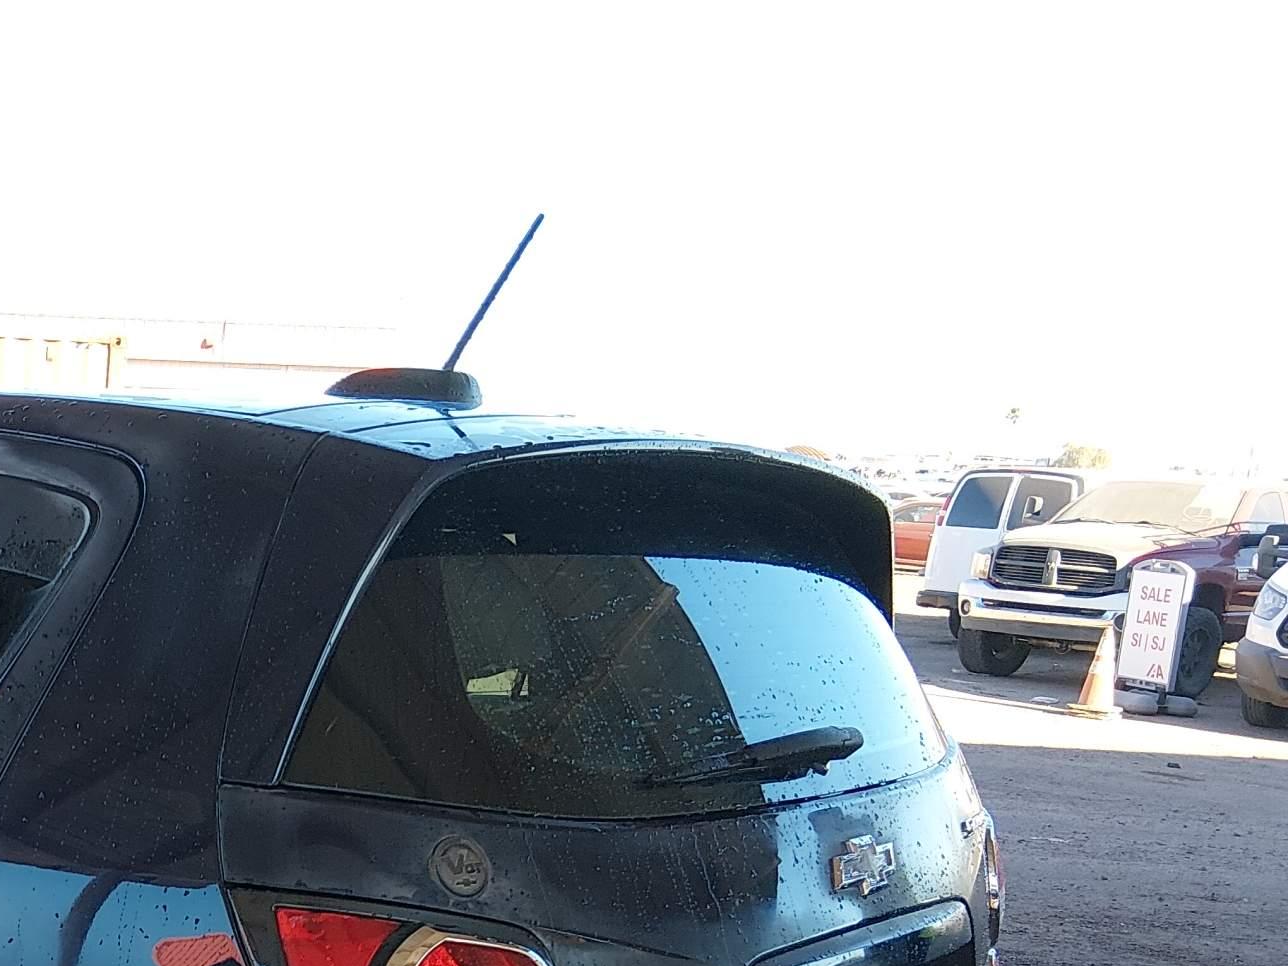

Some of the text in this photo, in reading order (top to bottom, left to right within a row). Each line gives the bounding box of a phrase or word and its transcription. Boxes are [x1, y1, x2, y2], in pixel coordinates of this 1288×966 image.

[1140, 585, 1172, 603] SALE
[1136, 609, 1168, 627] LANE
[1131, 632, 1143, 648] SI
[1151, 635, 1166, 652] SJ
